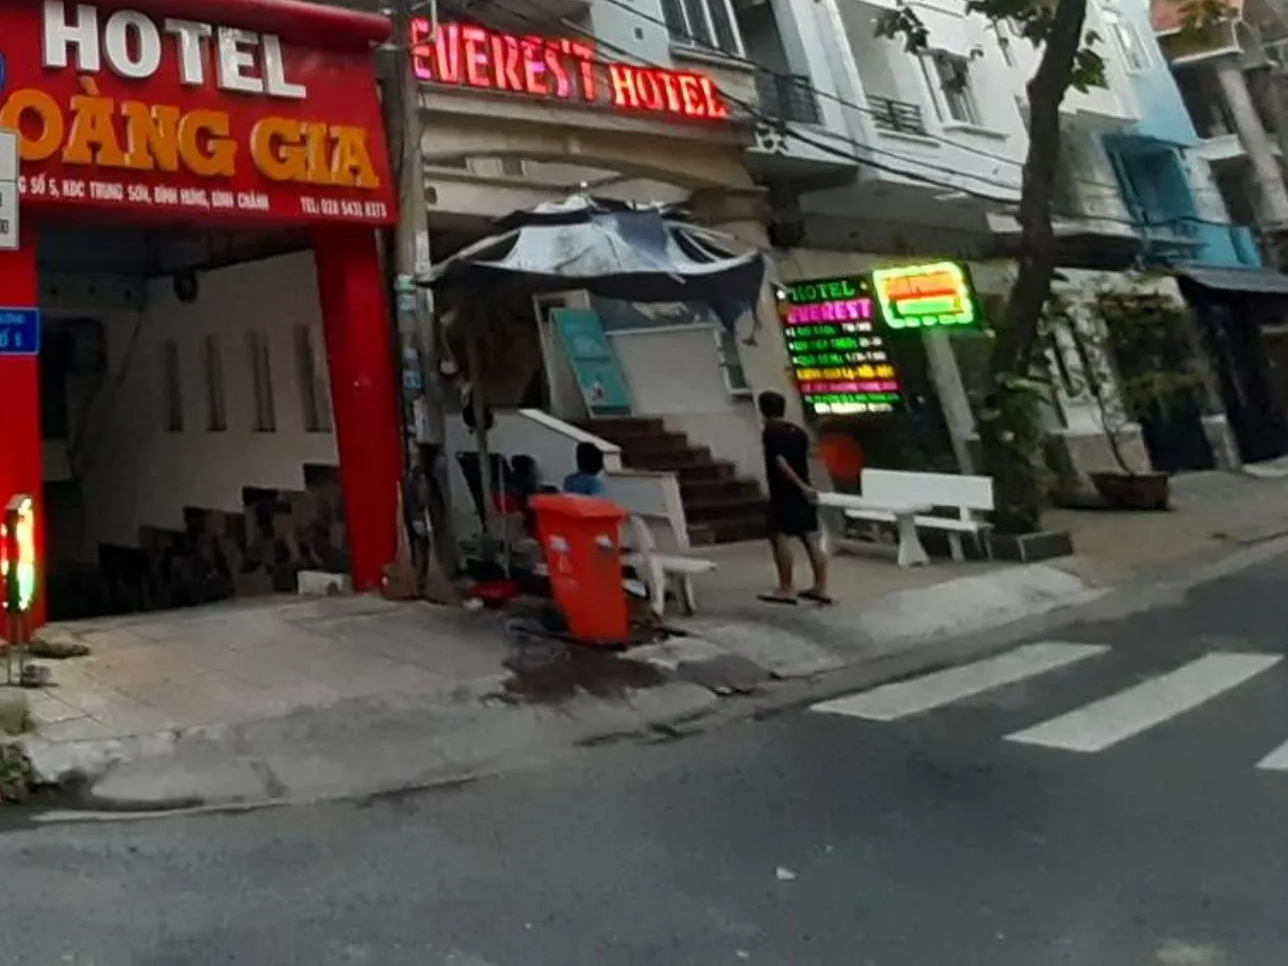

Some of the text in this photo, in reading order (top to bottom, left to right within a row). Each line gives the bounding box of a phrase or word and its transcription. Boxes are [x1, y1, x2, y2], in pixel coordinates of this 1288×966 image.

[410, 17, 729, 120] EVEREST HOTEL
[249, 116, 380, 188] GIA
[30, 173, 47, 195] SỐ
[62, 179, 85, 198] KDC
[89, 181, 124, 201] TRUNG
[790, 280, 856, 302] HOTEL
[786, 298, 872, 324] EVEREST
